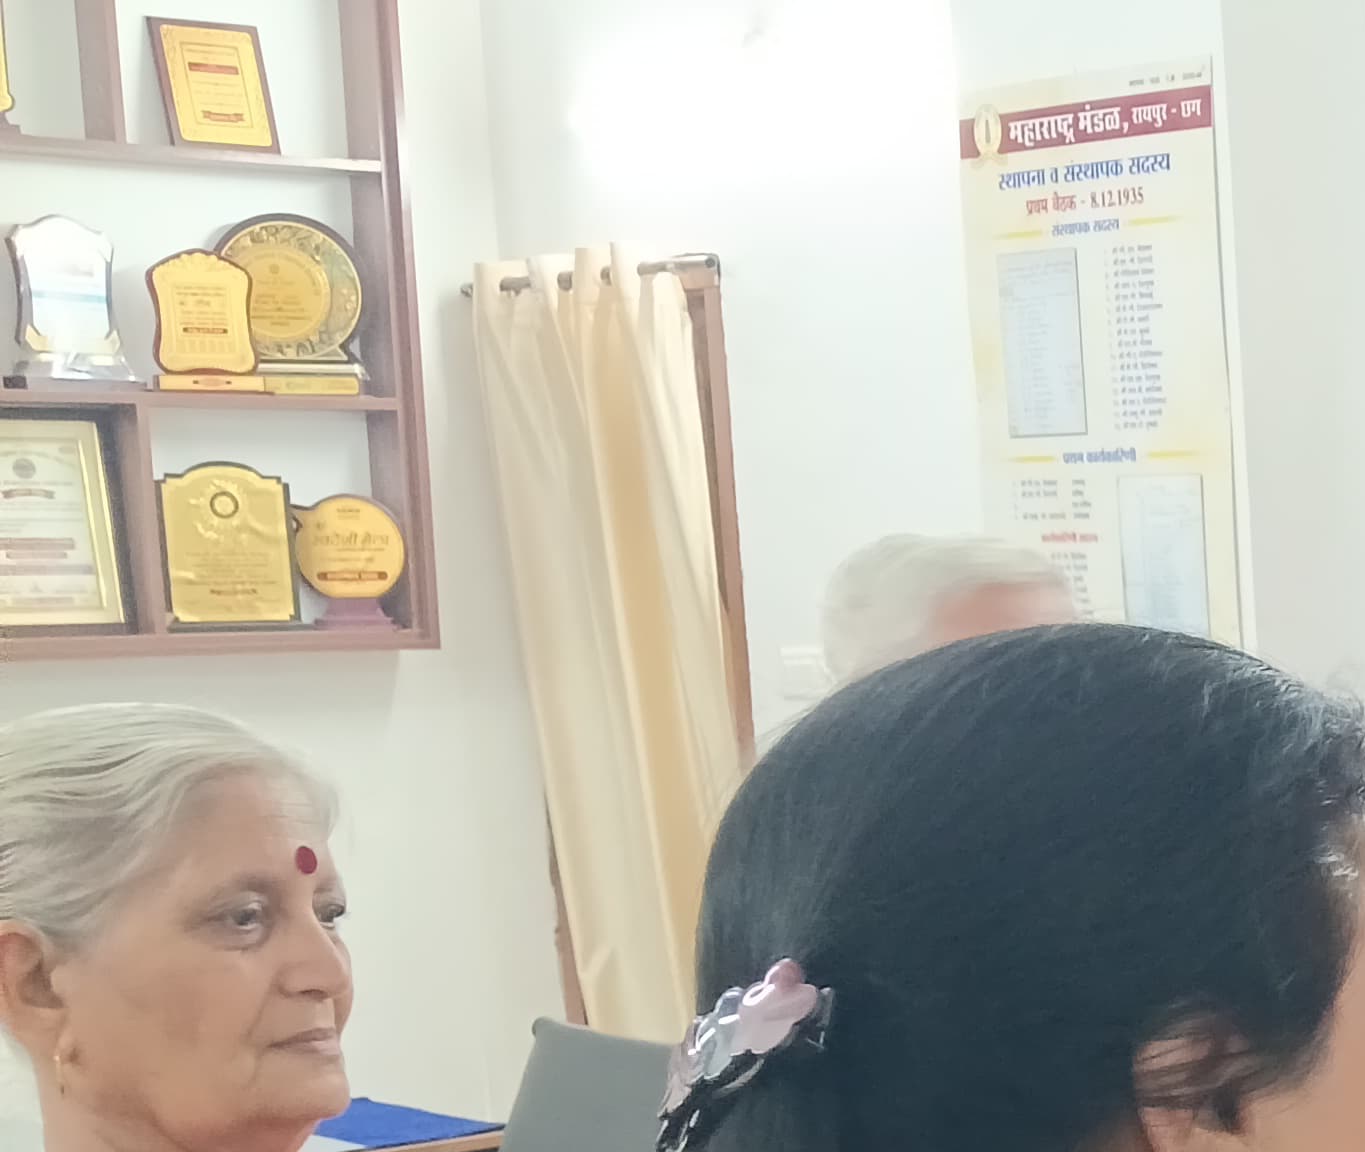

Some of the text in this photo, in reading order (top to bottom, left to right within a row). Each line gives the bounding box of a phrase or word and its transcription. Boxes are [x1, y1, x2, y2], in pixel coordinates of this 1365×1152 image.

[1008, 113, 1074, 148] महाराष्ट्र
[1132, 105, 1167, 128] रायपुर
[1180, 98, 1202, 117] छग
[998, 152, 1170, 190] स्थापना व संस्थापक सदस्य
[1026, 198, 1048, 216] प्रथम
[1090, 187, 1144, 208] 8.12.1935
